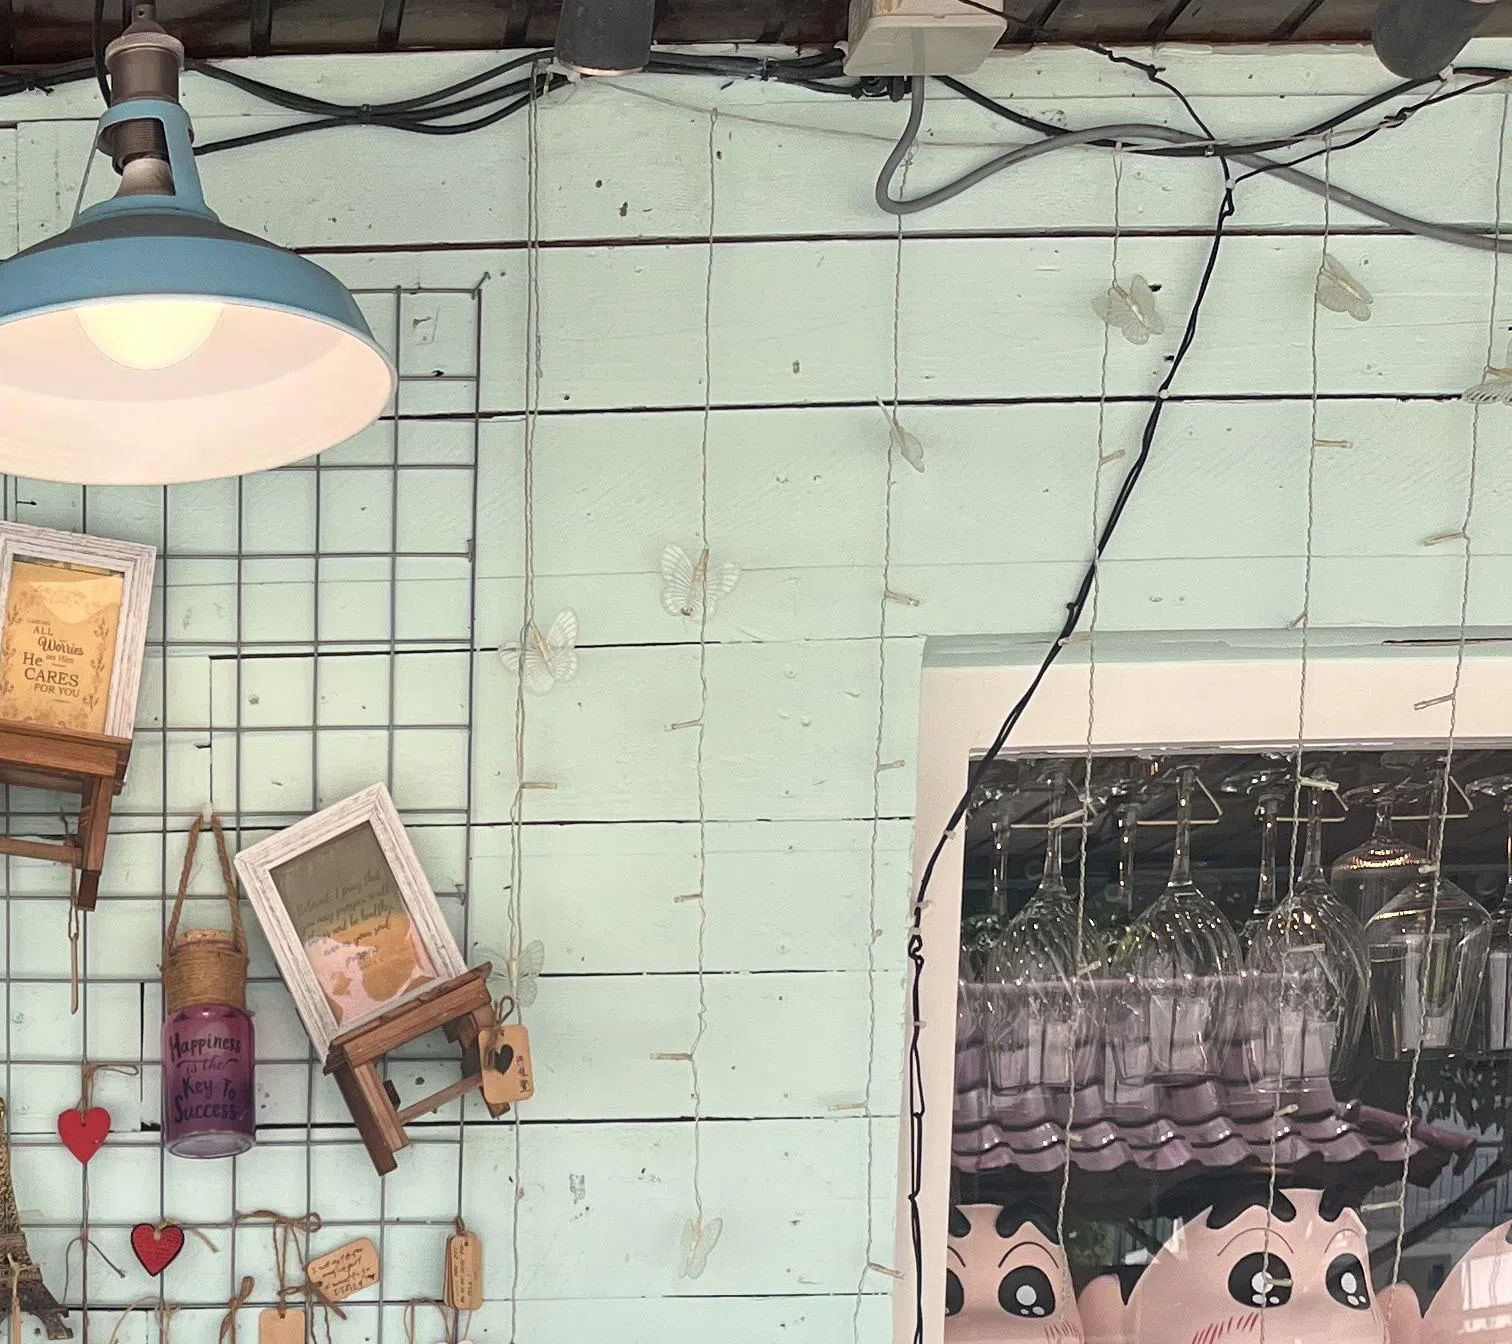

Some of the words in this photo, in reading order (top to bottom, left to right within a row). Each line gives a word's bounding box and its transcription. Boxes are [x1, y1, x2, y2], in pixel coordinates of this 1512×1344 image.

[33, 626, 54, 636] ALL
[37, 636, 84, 656] Worries
[23, 651, 43, 666] He
[24, 668, 79, 687] CARES
[33, 683, 55, 695] FOR
[58, 686, 80, 698] YOU
[169, 1032, 242, 1063] Happiness
[182, 1077, 213, 1099] Key
[174, 1096, 238, 1124] Success
